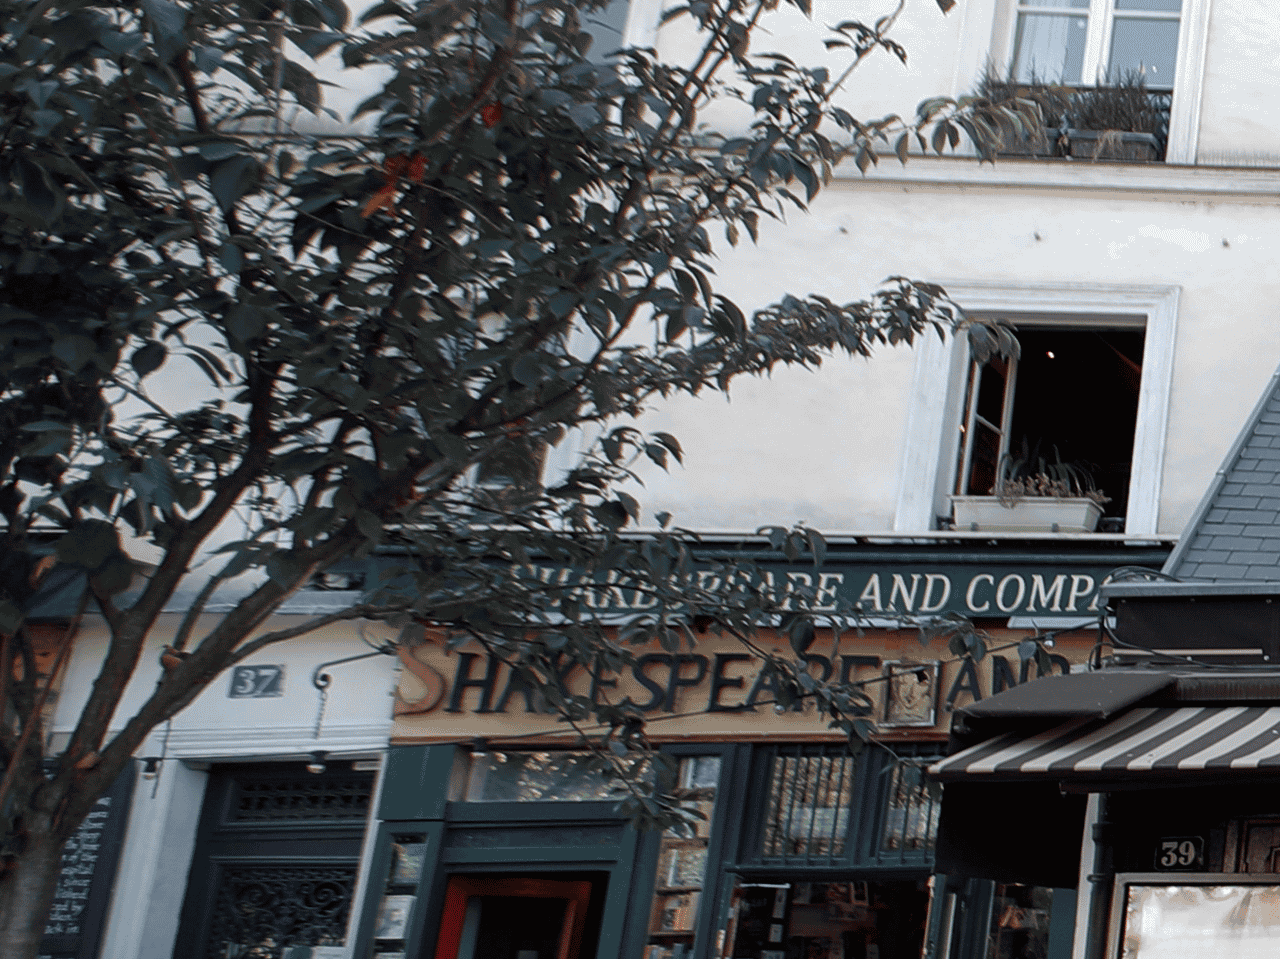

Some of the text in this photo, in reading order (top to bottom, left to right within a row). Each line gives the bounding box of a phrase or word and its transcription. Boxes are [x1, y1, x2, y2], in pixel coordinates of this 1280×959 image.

[508, 563, 1101, 613] HAKEPARE AND COMP
[235, 669, 279, 694] 37
[1161, 841, 1196, 867] 39
